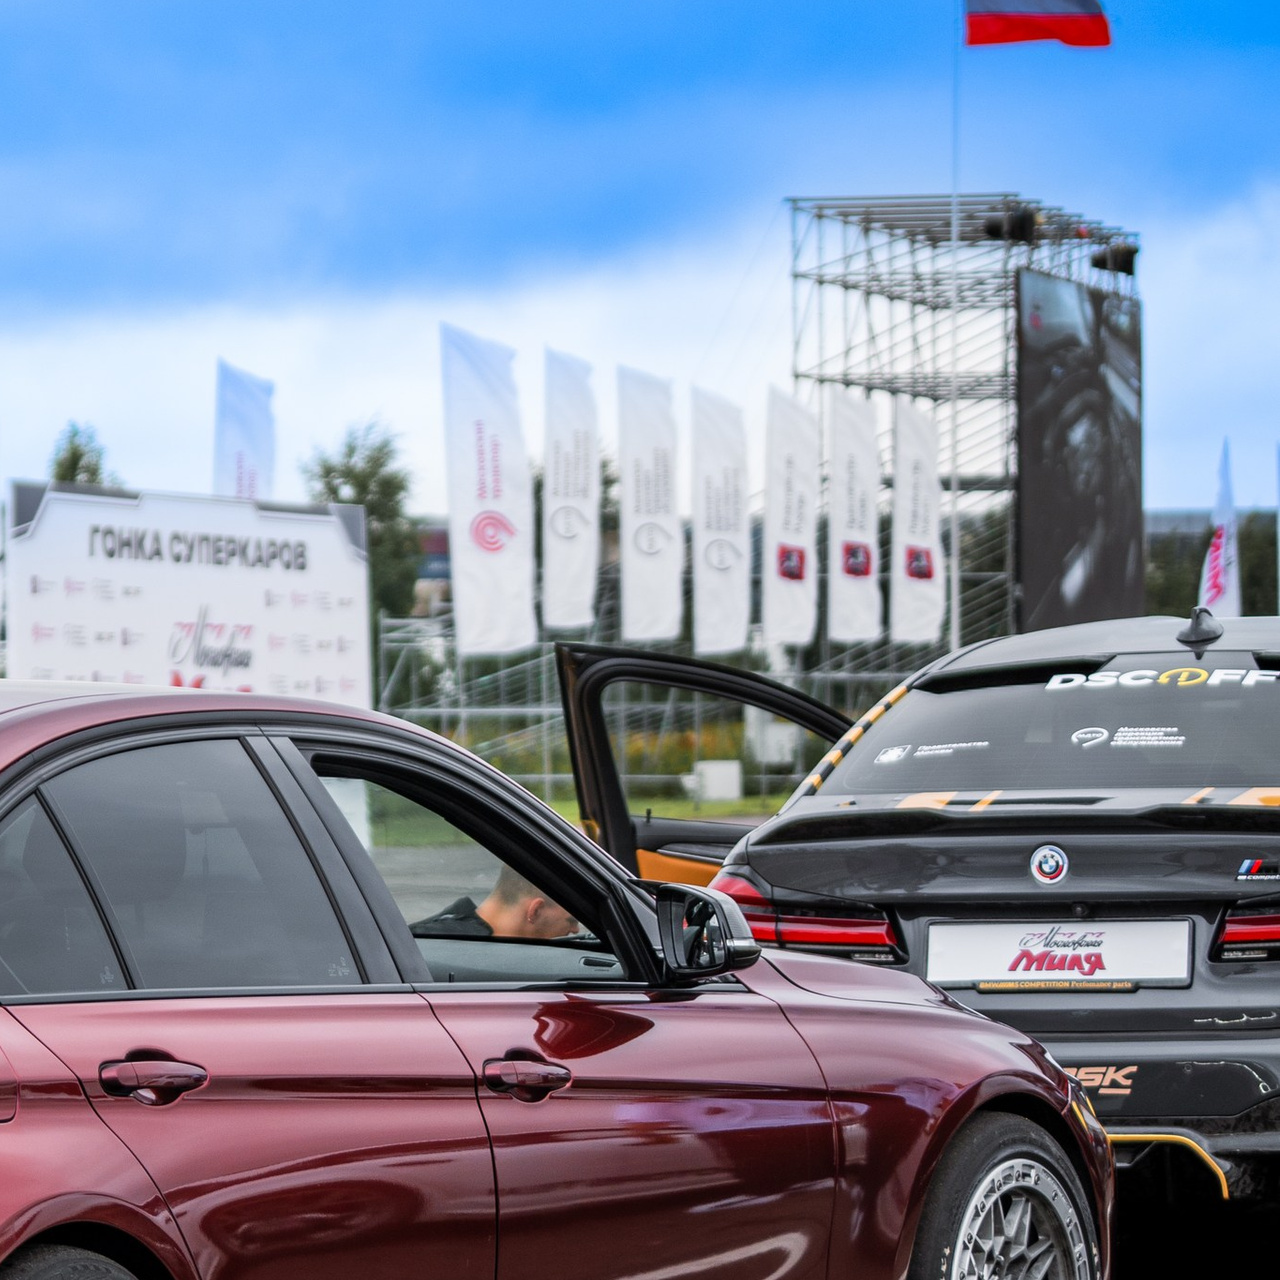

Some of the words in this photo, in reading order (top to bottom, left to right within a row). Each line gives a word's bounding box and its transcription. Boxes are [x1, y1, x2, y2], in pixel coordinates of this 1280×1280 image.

[90, 524, 163, 561] ГОНКА
[171, 532, 307, 570] СУПЕРКАРОВ
[1019, 926, 1104, 950] Московская
[1008, 949, 1107, 976] Миля
[1020, 981, 1070, 989] COMPETITION
[1112, 981, 1132, 989] parts
